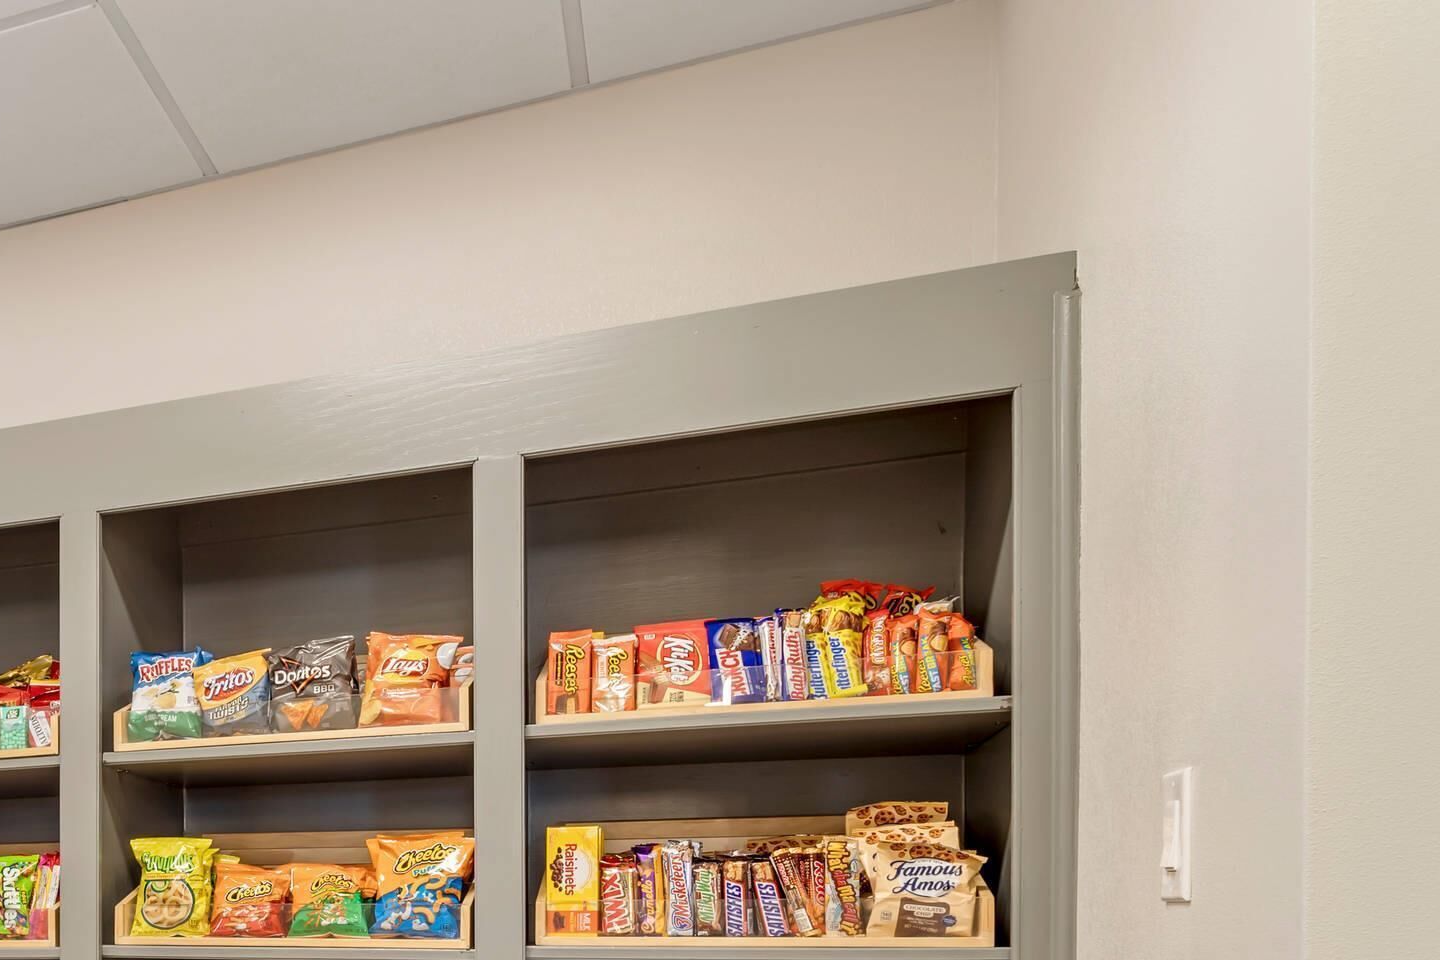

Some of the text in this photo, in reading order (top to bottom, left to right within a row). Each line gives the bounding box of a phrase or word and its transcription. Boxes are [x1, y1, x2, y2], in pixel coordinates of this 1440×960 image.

[834, 637, 852, 690] tterfinger
[871, 633, 887, 665] GRAND
[139, 657, 193, 683] RUFFLES
[274, 664, 331, 685] Doritos
[382, 657, 428, 677] Lay's
[565, 644, 585, 695] Reese's
[203, 669, 256, 701] Fritos
[313, 684, 335, 693] BBQ
[393, 844, 458, 874] Cheetos
[413, 865, 440, 877] Puff
[564, 843, 578, 896] Raisinets
[887, 860, 962, 881] Famous
[2, 866, 20, 929] Skittles
[225, 880, 273, 902] Cheetos
[310, 874, 354, 892] Cheetos
[674, 854, 690, 918] Musketeers
[892, 877, 951, 894] Amos
[601, 872, 626, 933] TWIX
[725, 881, 743, 937] SATISFIES
[757, 881, 784, 937] SATISFIES
